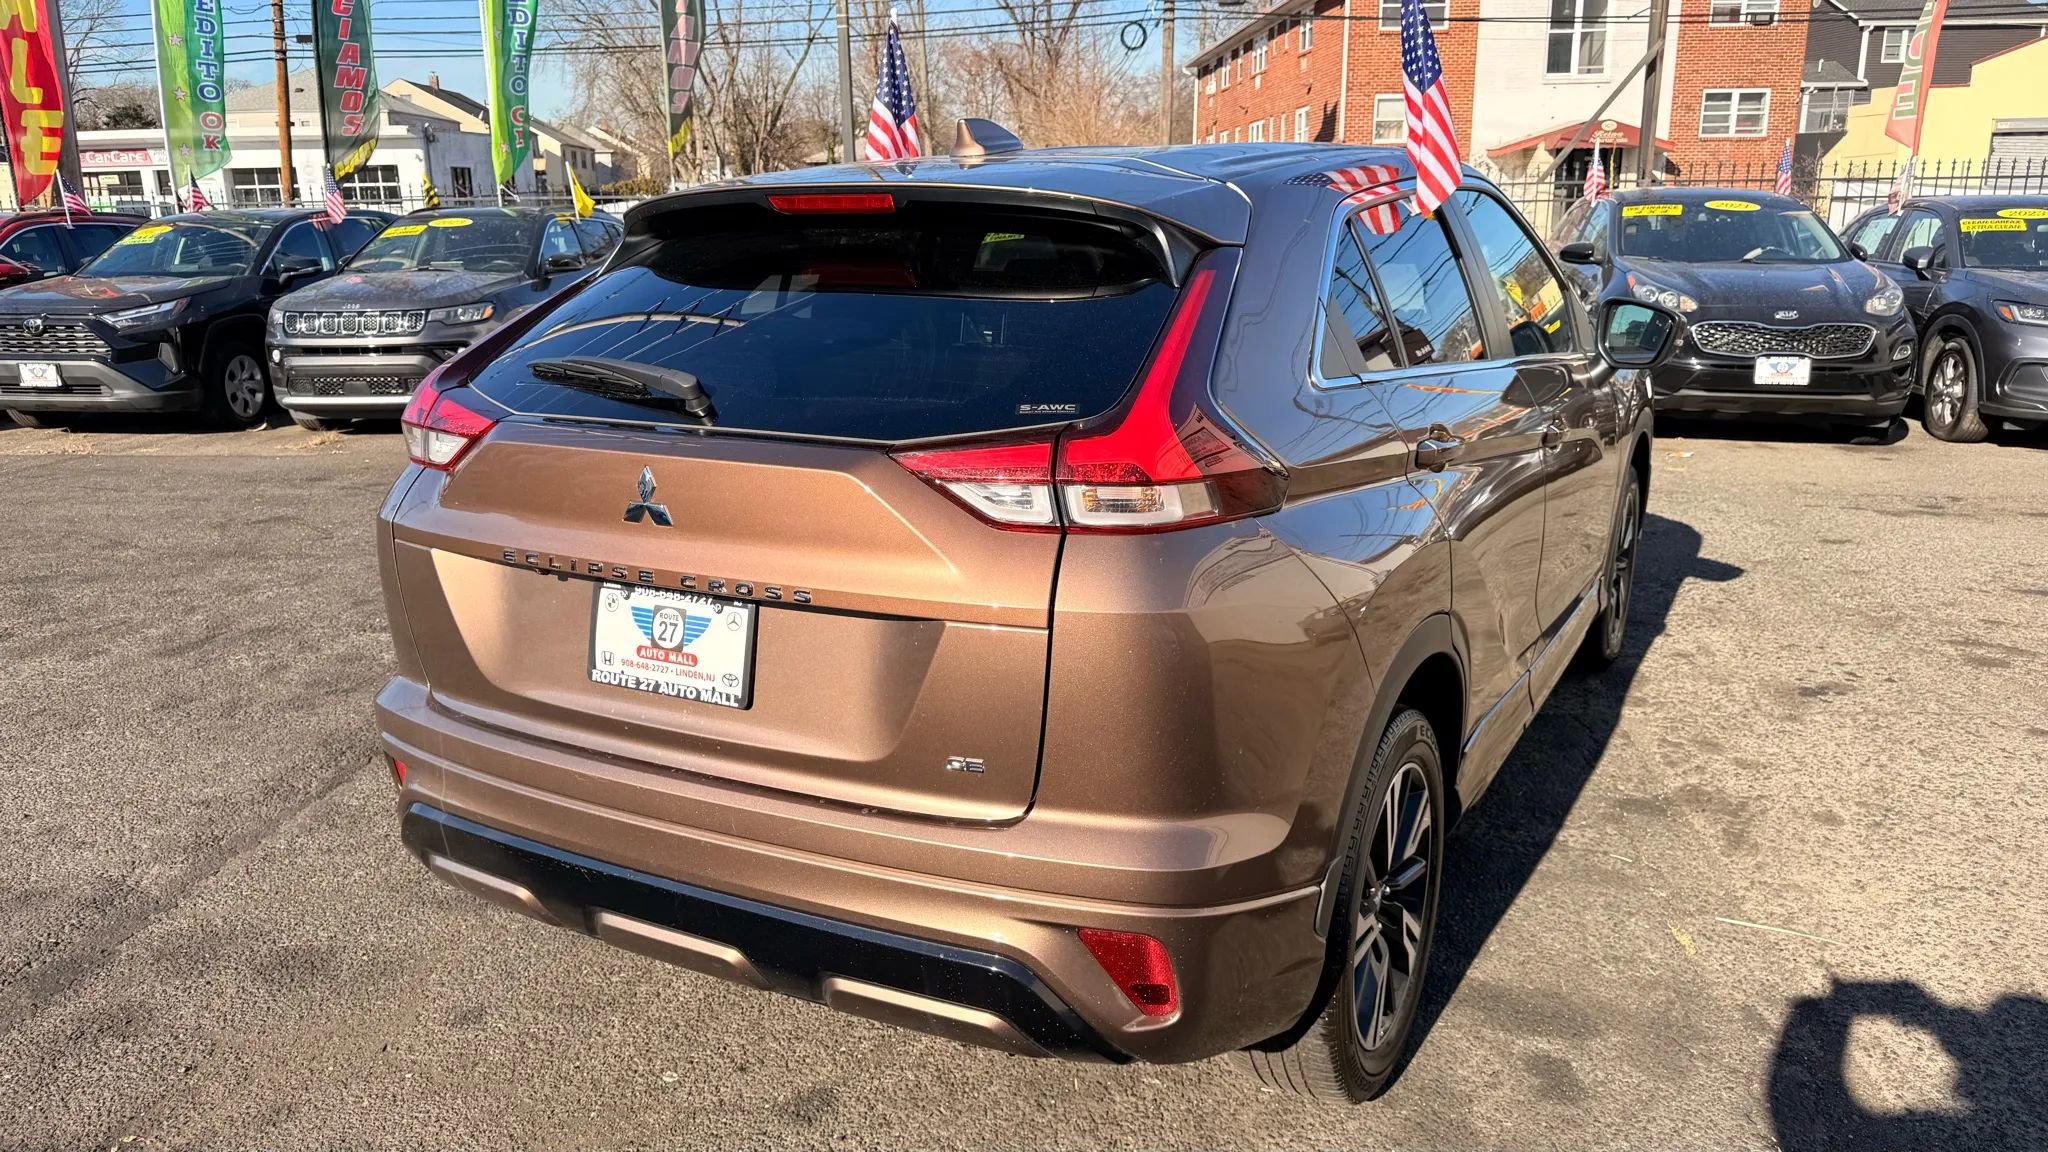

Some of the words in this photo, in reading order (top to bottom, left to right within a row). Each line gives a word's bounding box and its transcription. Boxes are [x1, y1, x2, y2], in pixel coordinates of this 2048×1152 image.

[508, 0, 531, 95] DITO
[200, 112, 223, 150] OK
[86, 151, 144, 163] CarCare
[502, 549, 656, 583] ECLIPSE
[681, 574, 812, 604] CROSS
[659, 612, 680, 622] ROUTE
[658, 620, 679, 643] 27
[620, 658, 669, 674] 908-648-2727
[640, 646, 666, 660] AUTO
[668, 651, 695, 665] MALL
[592, 668, 637, 688] ROUTE
[639, 677, 656, 692] 27
[658, 680, 697, 699] AUTO
[700, 689, 739, 707] MALL
